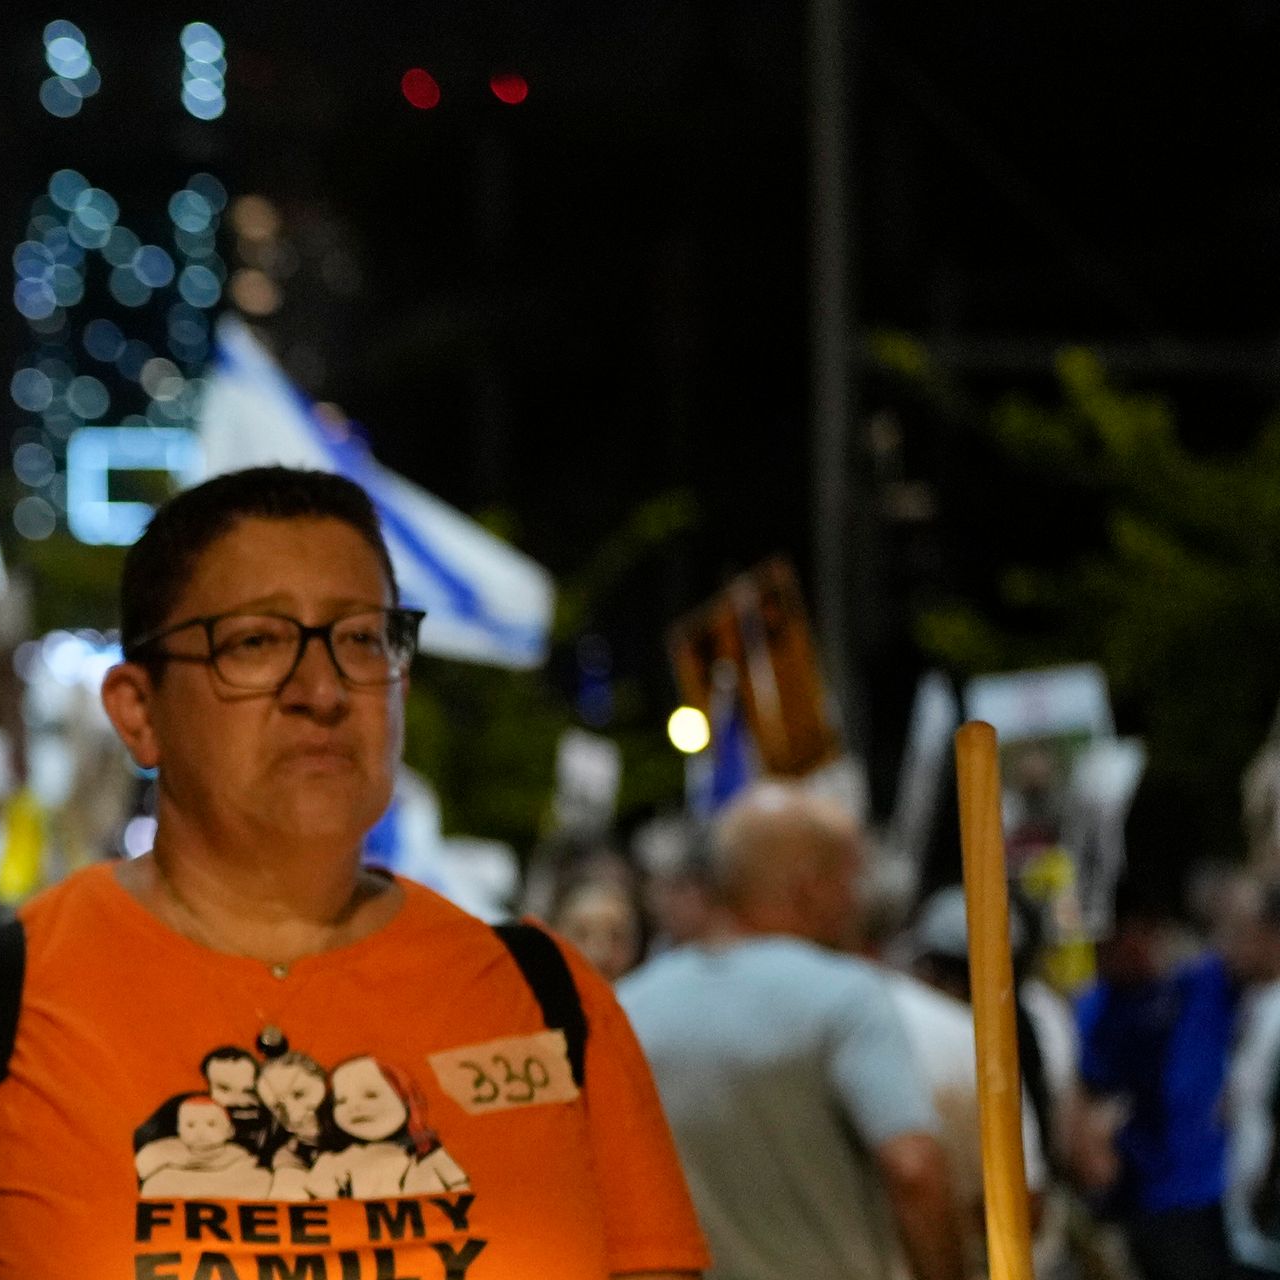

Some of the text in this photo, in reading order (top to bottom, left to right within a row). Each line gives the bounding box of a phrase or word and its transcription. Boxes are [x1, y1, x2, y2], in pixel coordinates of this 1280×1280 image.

[459, 1052, 550, 1105] 330
[135, 1194, 477, 1244] FREE MY
